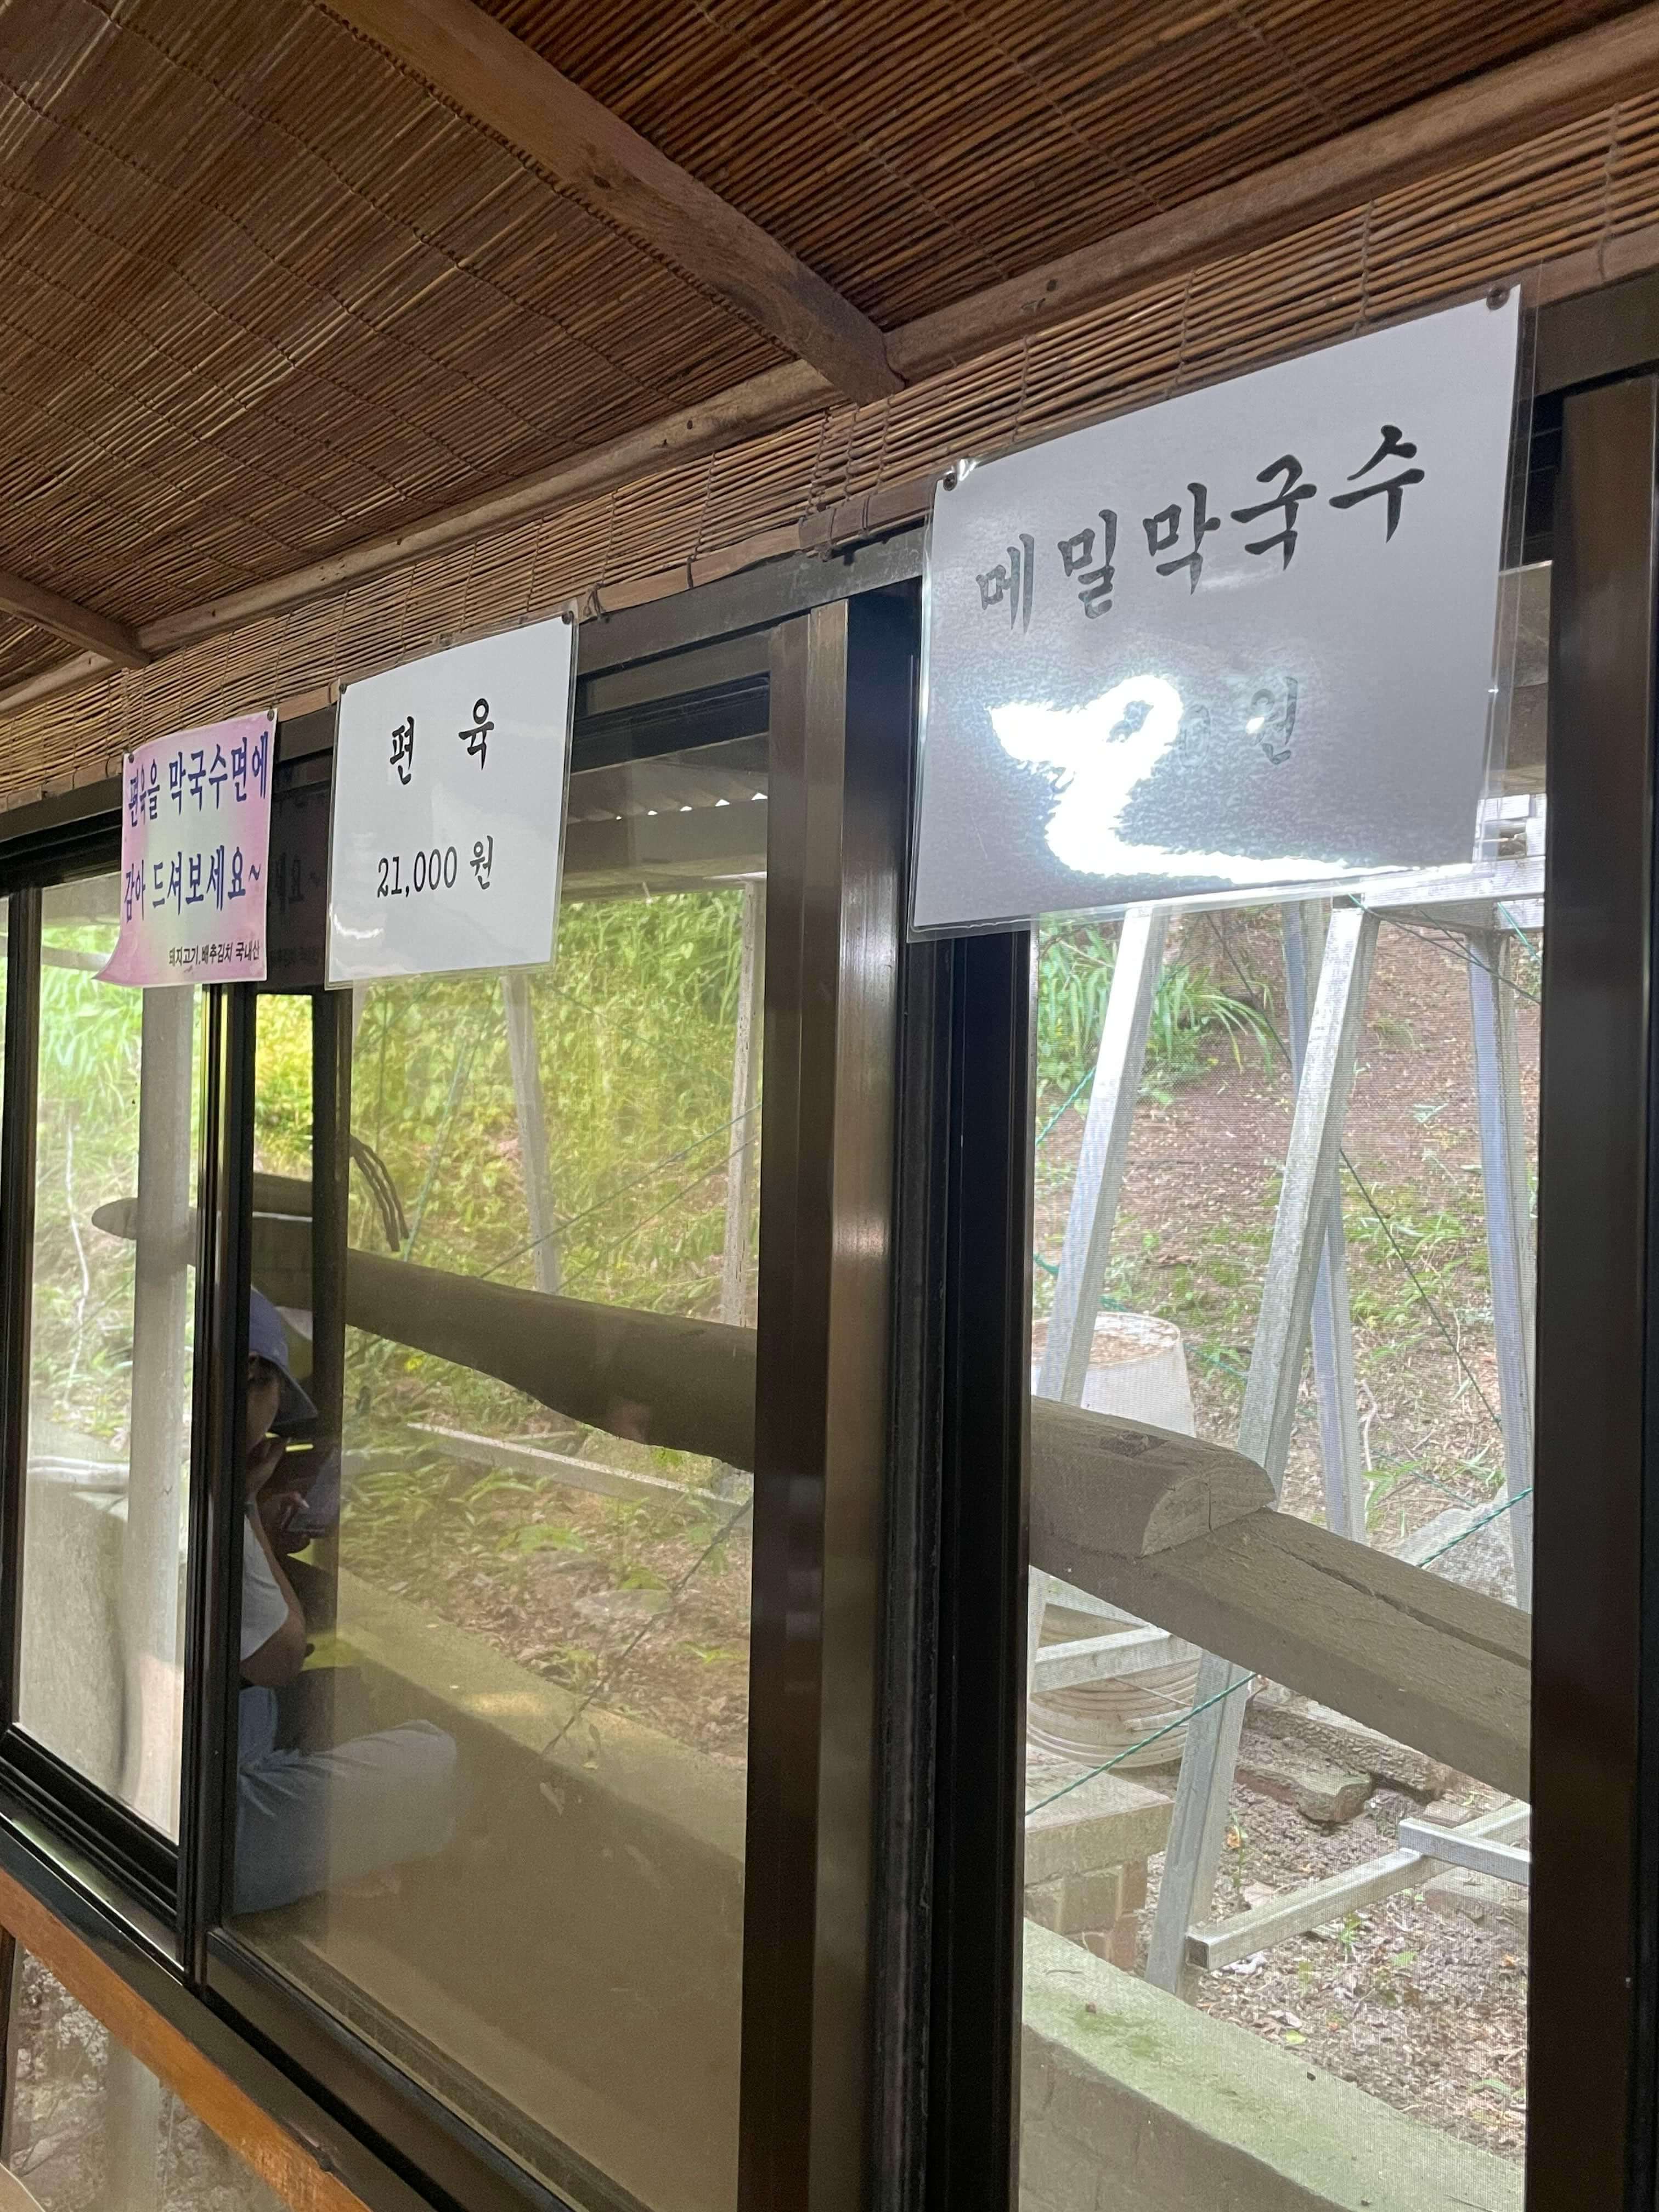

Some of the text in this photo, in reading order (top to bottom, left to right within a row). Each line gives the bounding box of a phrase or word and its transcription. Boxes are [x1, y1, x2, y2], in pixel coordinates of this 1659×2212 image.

[975, 424, 1425, 634] 메밀막국수
[128, 731, 268, 827] 편육을 막국수면에
[124, 859, 146, 924] 감아
[377, 846, 458, 898] 21,000
[470, 835, 493, 890] 원
[236, 940, 259, 961] 국내산
